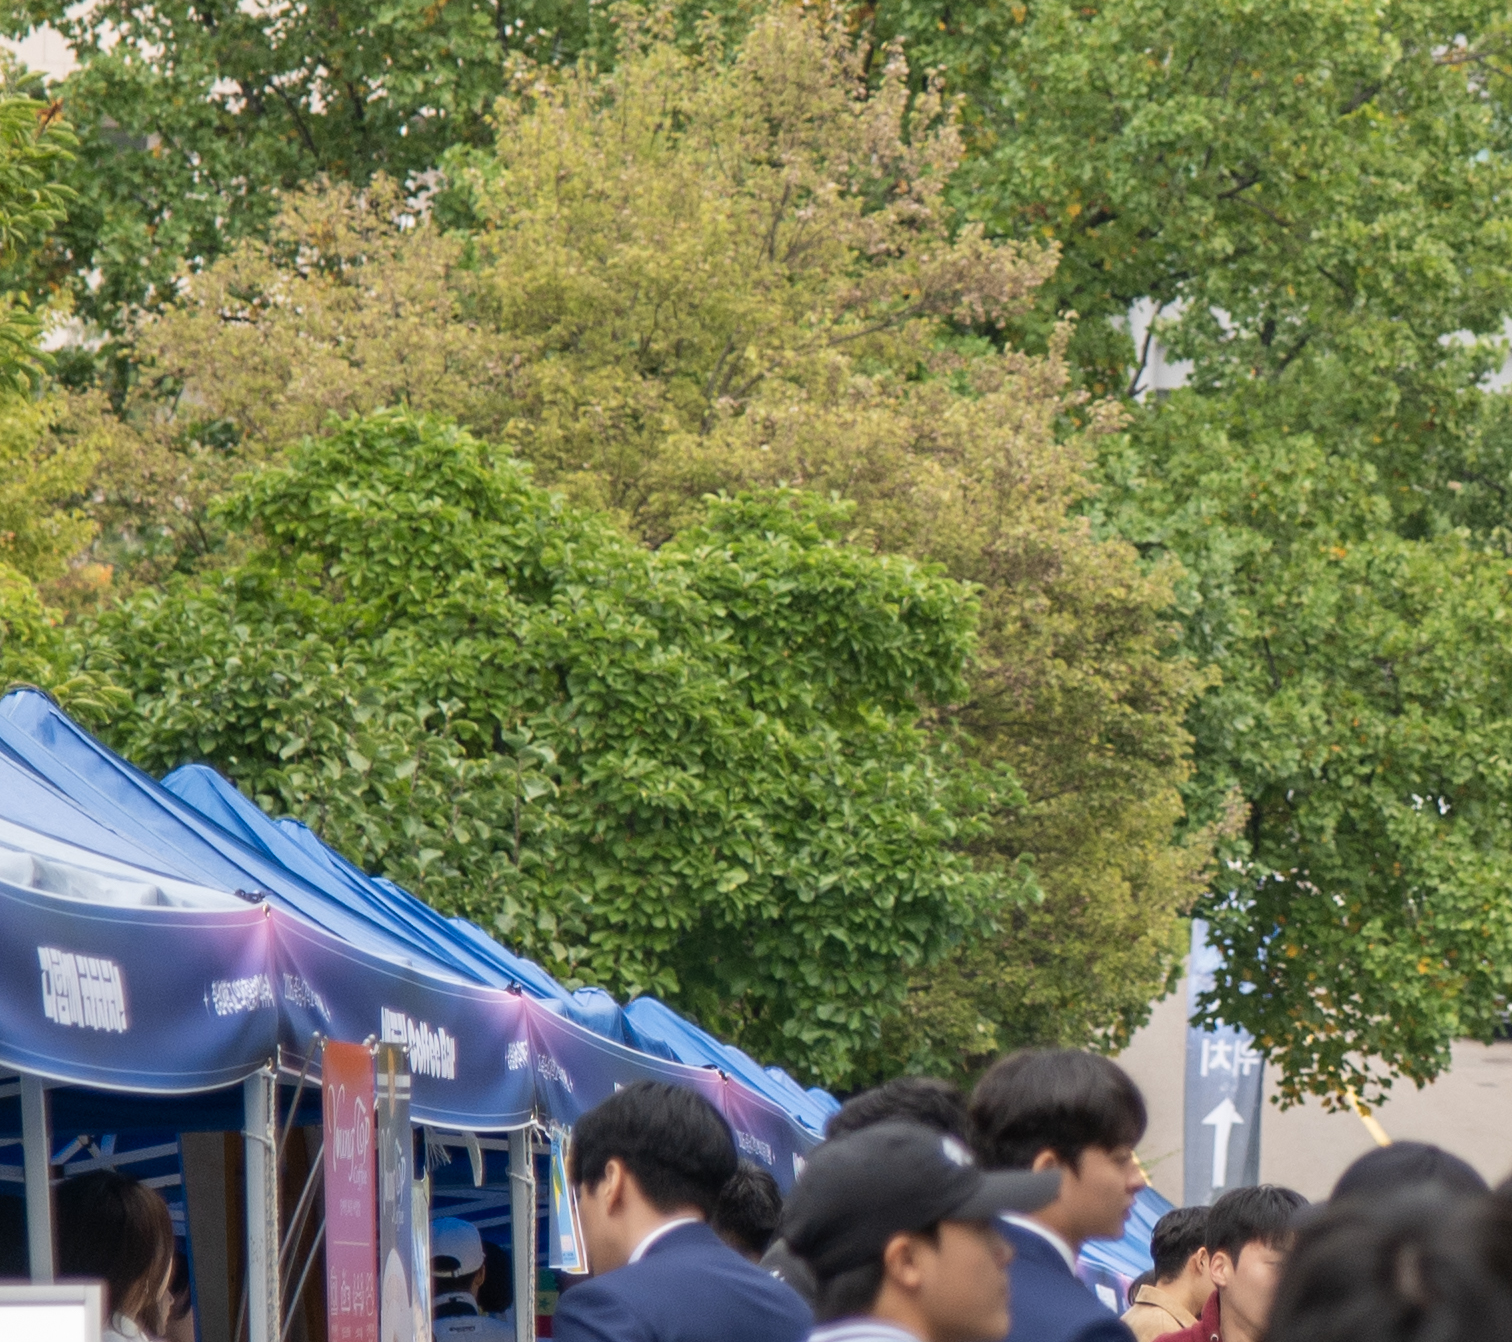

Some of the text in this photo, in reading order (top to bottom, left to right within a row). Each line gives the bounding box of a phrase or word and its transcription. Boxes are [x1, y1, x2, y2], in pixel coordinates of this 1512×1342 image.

[36, 946, 128, 1034] 다함께 차차차!
[407, 1017, 441, 1079] Coffee
[437, 1027, 456, 1081] Bar
[327, 1083, 355, 1183] Young
